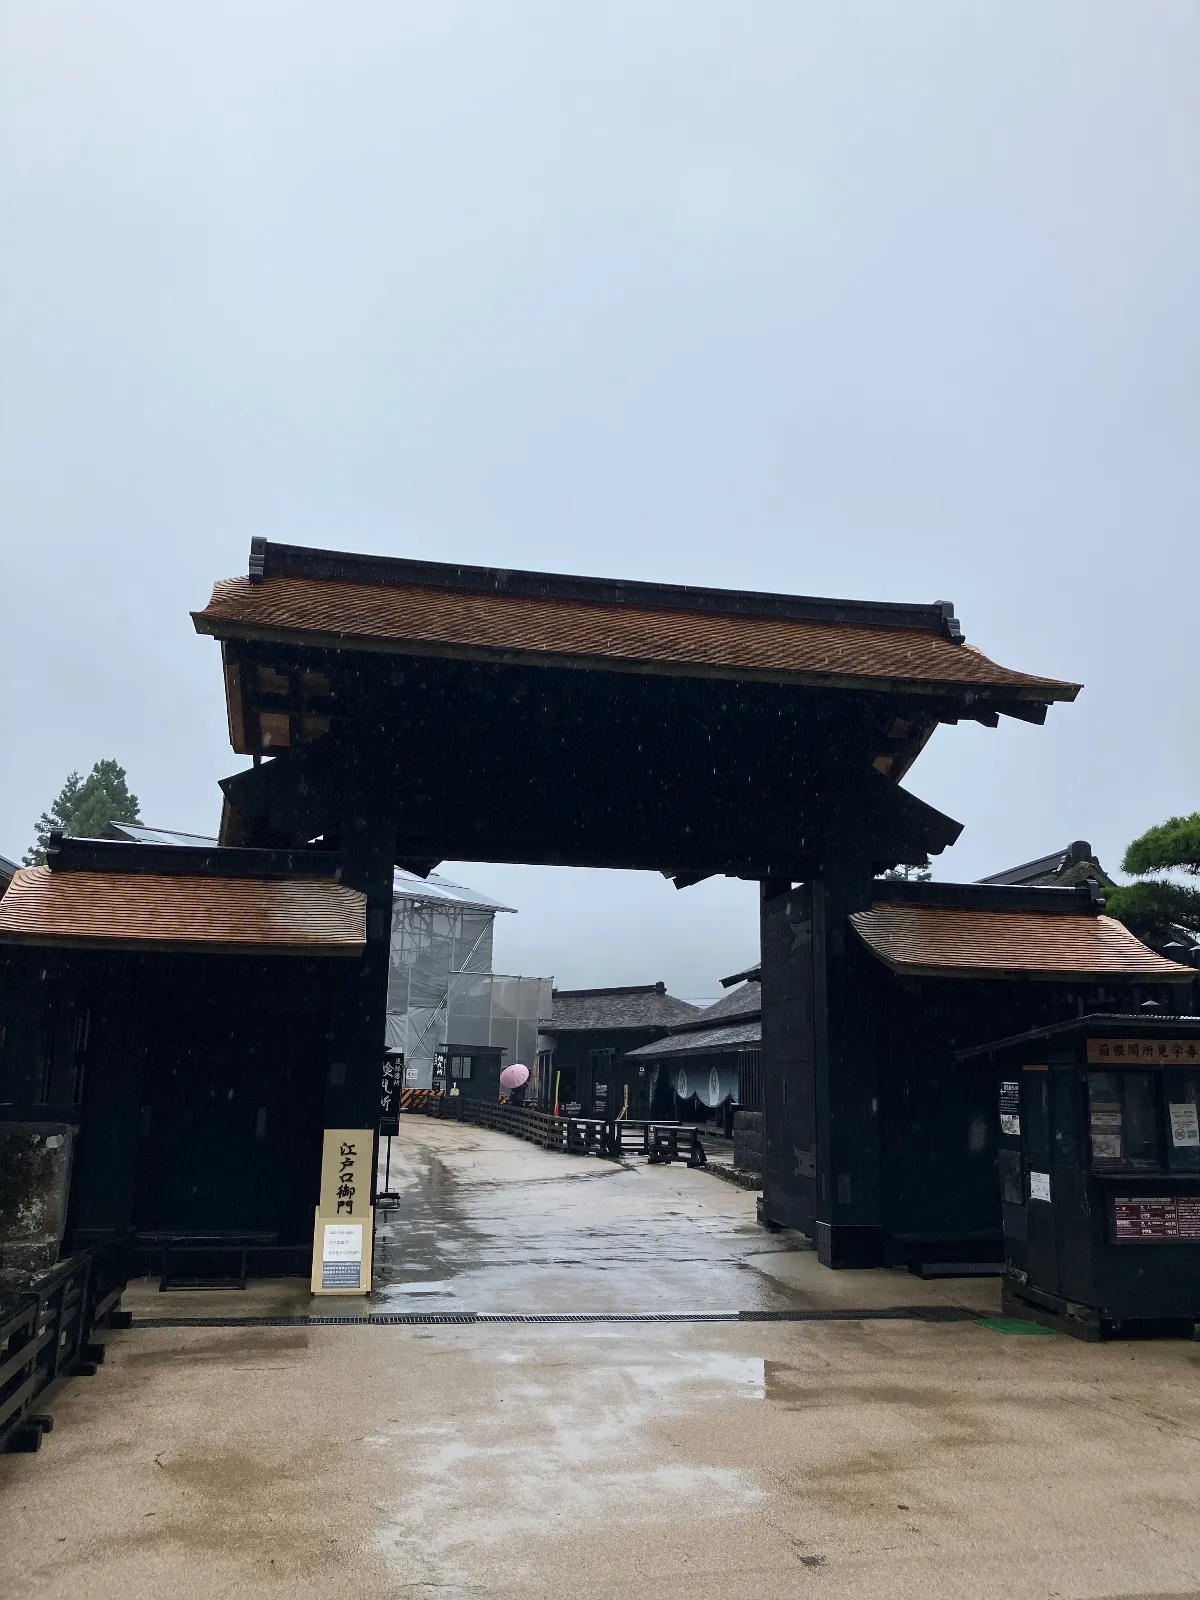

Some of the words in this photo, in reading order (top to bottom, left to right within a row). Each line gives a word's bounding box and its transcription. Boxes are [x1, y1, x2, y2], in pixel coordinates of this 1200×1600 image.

[336, 1142, 358, 1215] 江戸口御門
